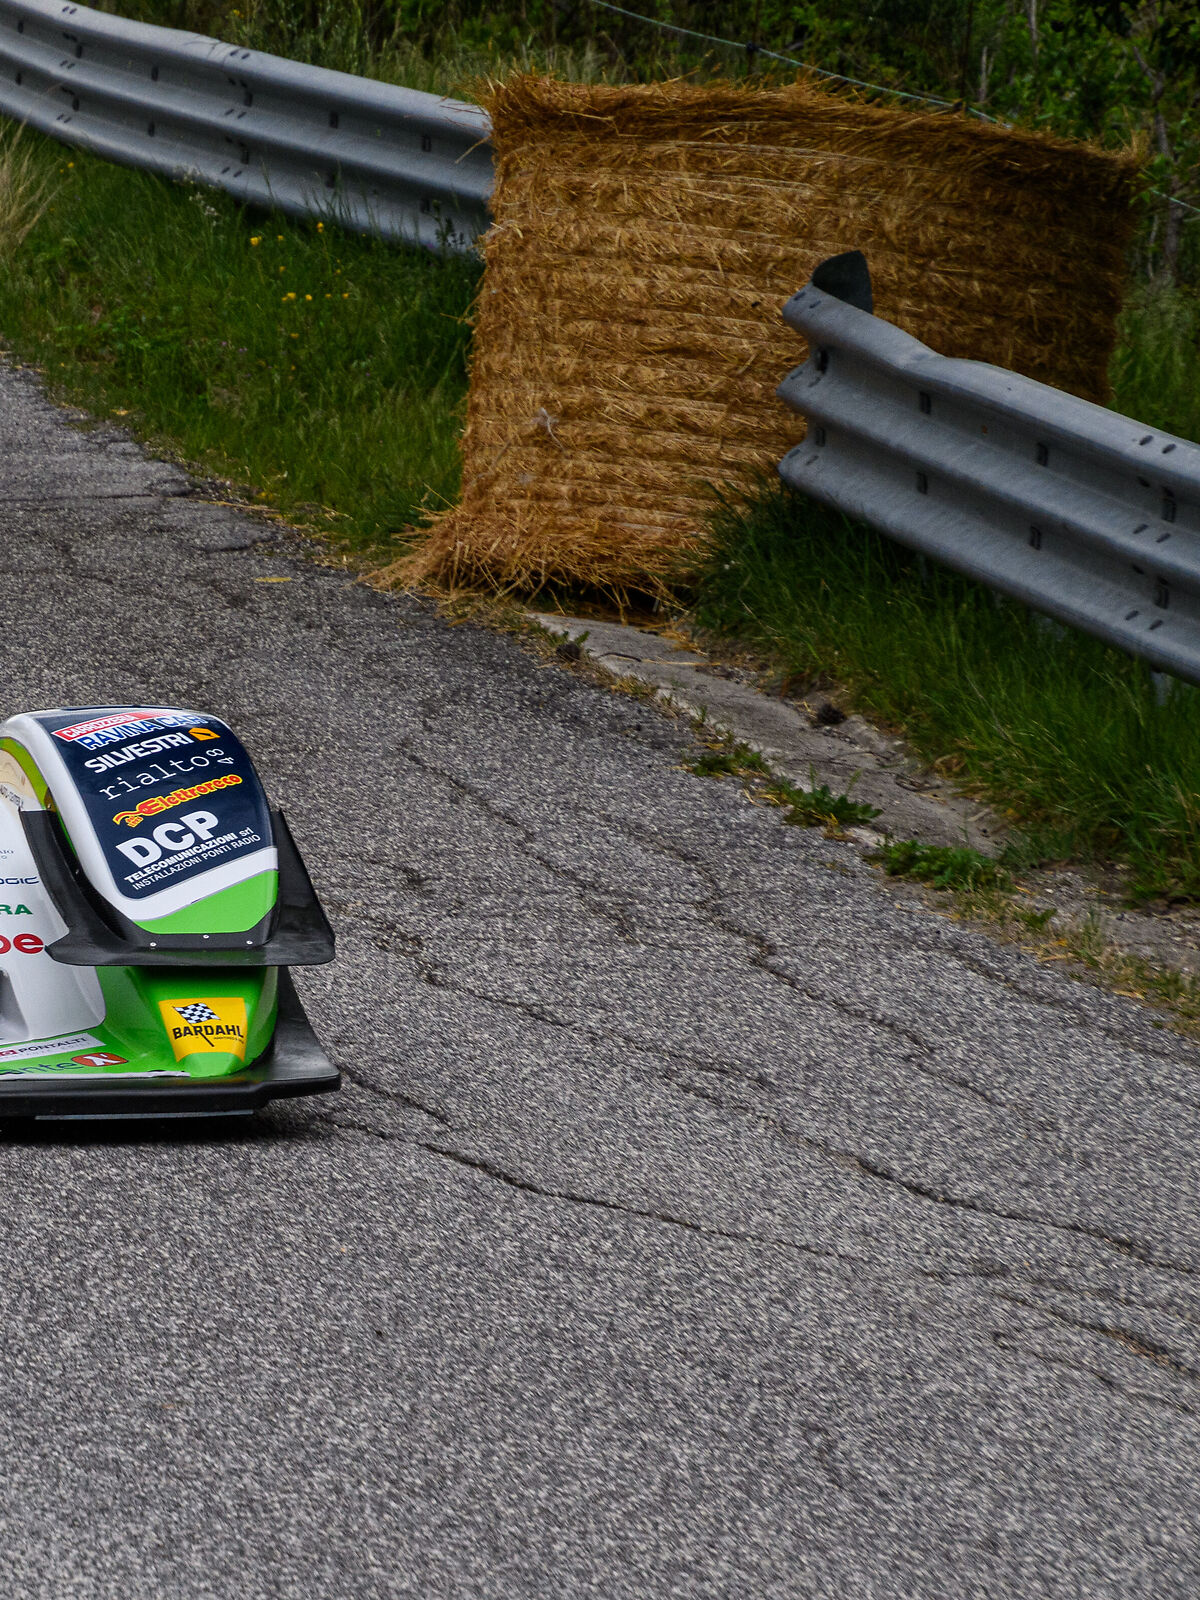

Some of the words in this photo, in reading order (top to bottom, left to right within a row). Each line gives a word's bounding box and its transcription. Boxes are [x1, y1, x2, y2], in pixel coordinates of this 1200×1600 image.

[62, 715, 138, 740] CARROZZERIA
[76, 719, 160, 750] RAVINA
[156, 713, 209, 729] CAR
[84, 732, 195, 774] SILVESTRI
[100, 755, 210, 800] rialto
[115, 810, 219, 869] DCP
[124, 832, 238, 884] TELECOMUNICAZIONI
[240, 827, 254, 838] srl
[132, 855, 203, 890] INSTALLAZIONI
[202, 846, 232, 861] PONTI
[232, 834, 261, 850] RADIO
[172, 1024, 245, 1040] BARDAHL
